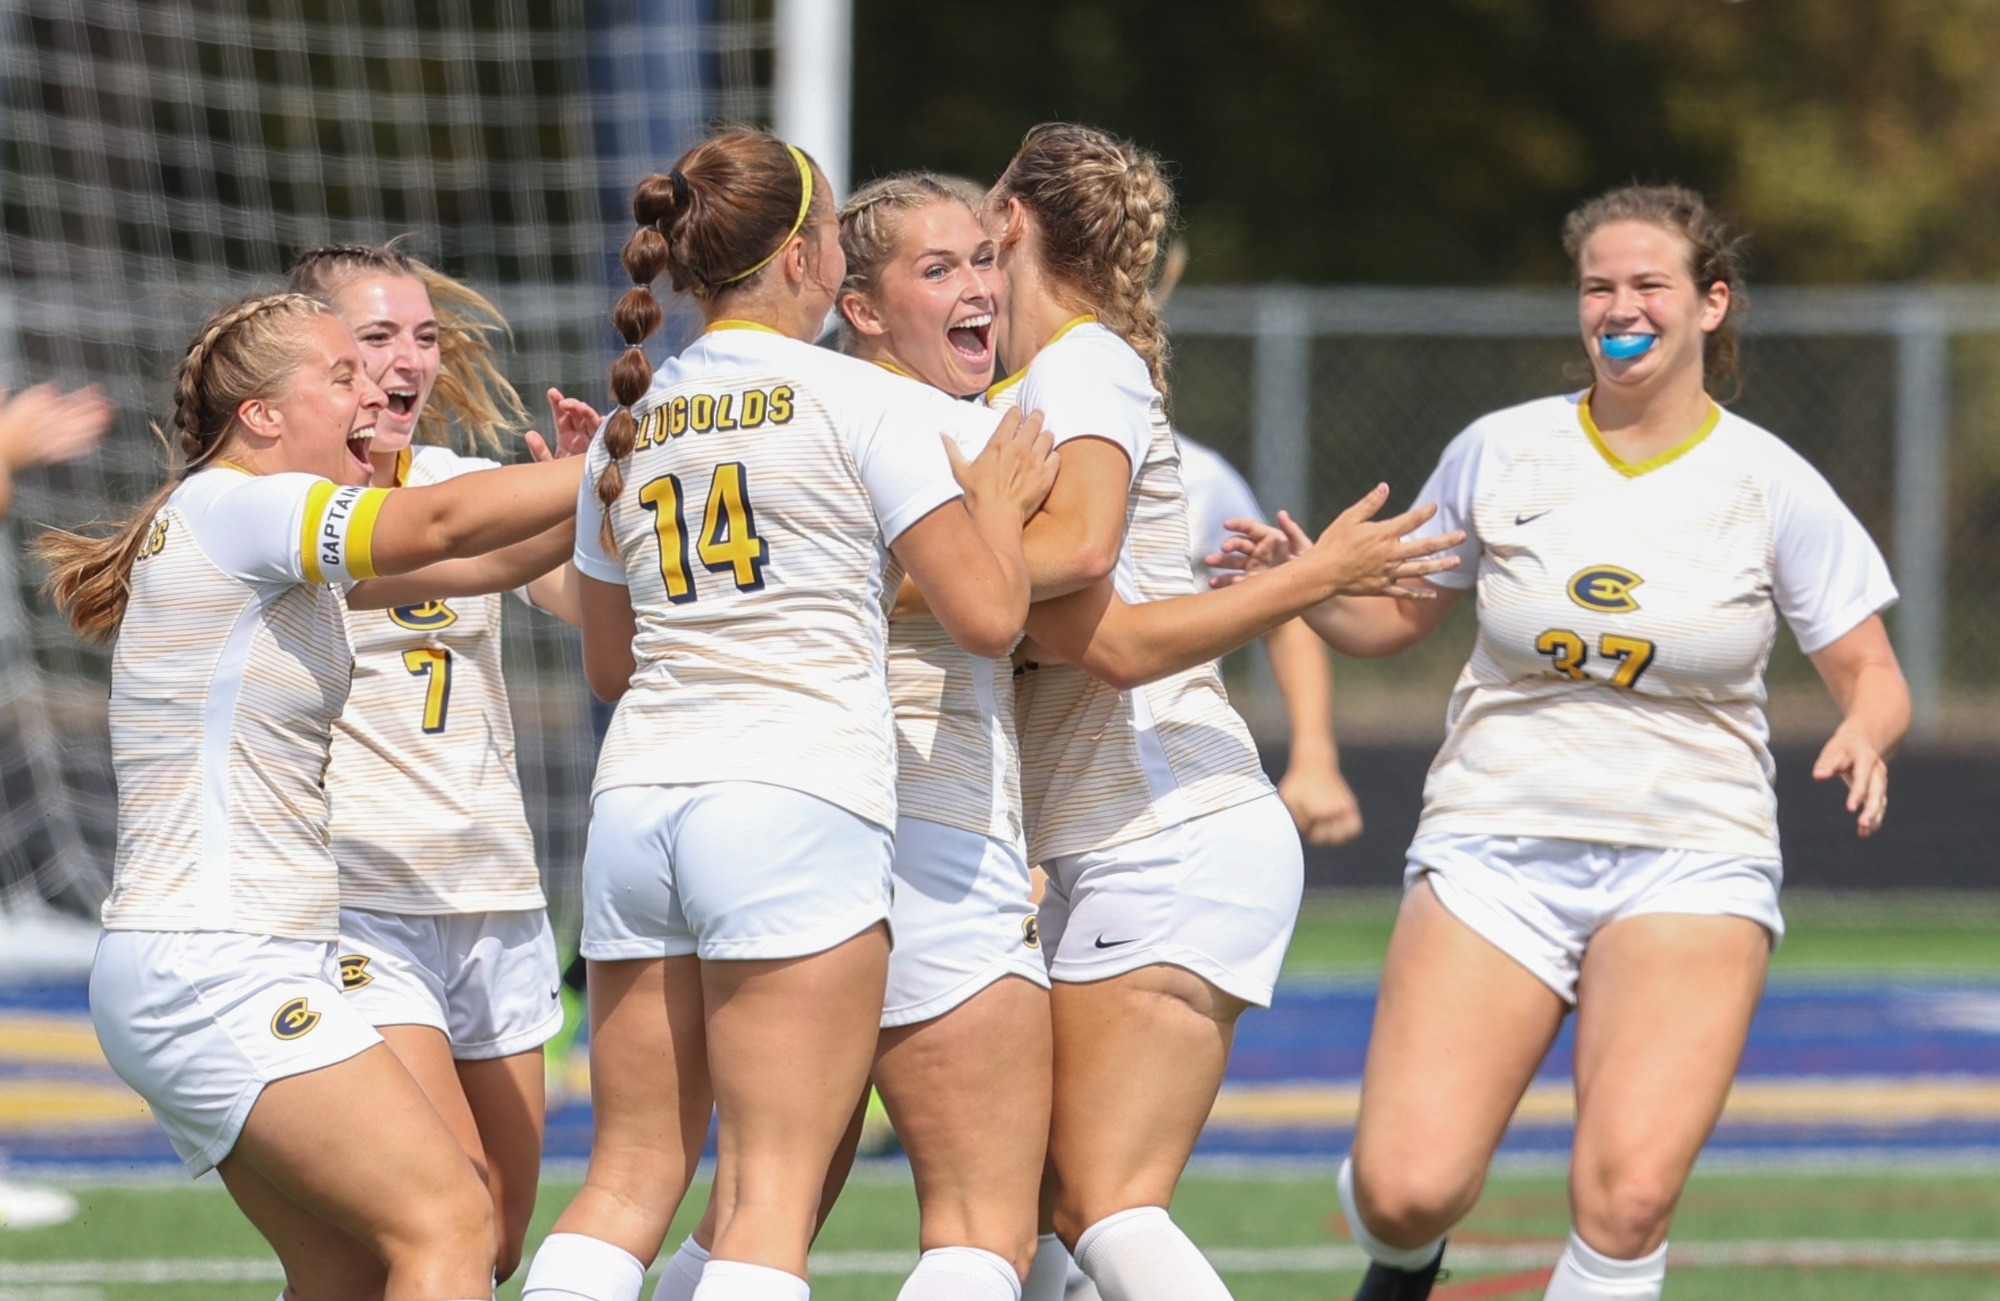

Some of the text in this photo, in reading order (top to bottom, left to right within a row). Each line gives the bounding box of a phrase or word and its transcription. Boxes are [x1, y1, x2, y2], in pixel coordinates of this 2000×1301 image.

[633, 384, 795, 452] LUGOLDS
[638, 460, 770, 604] 14
[401, 647, 453, 735] 7
[1535, 627, 1657, 689] 37
